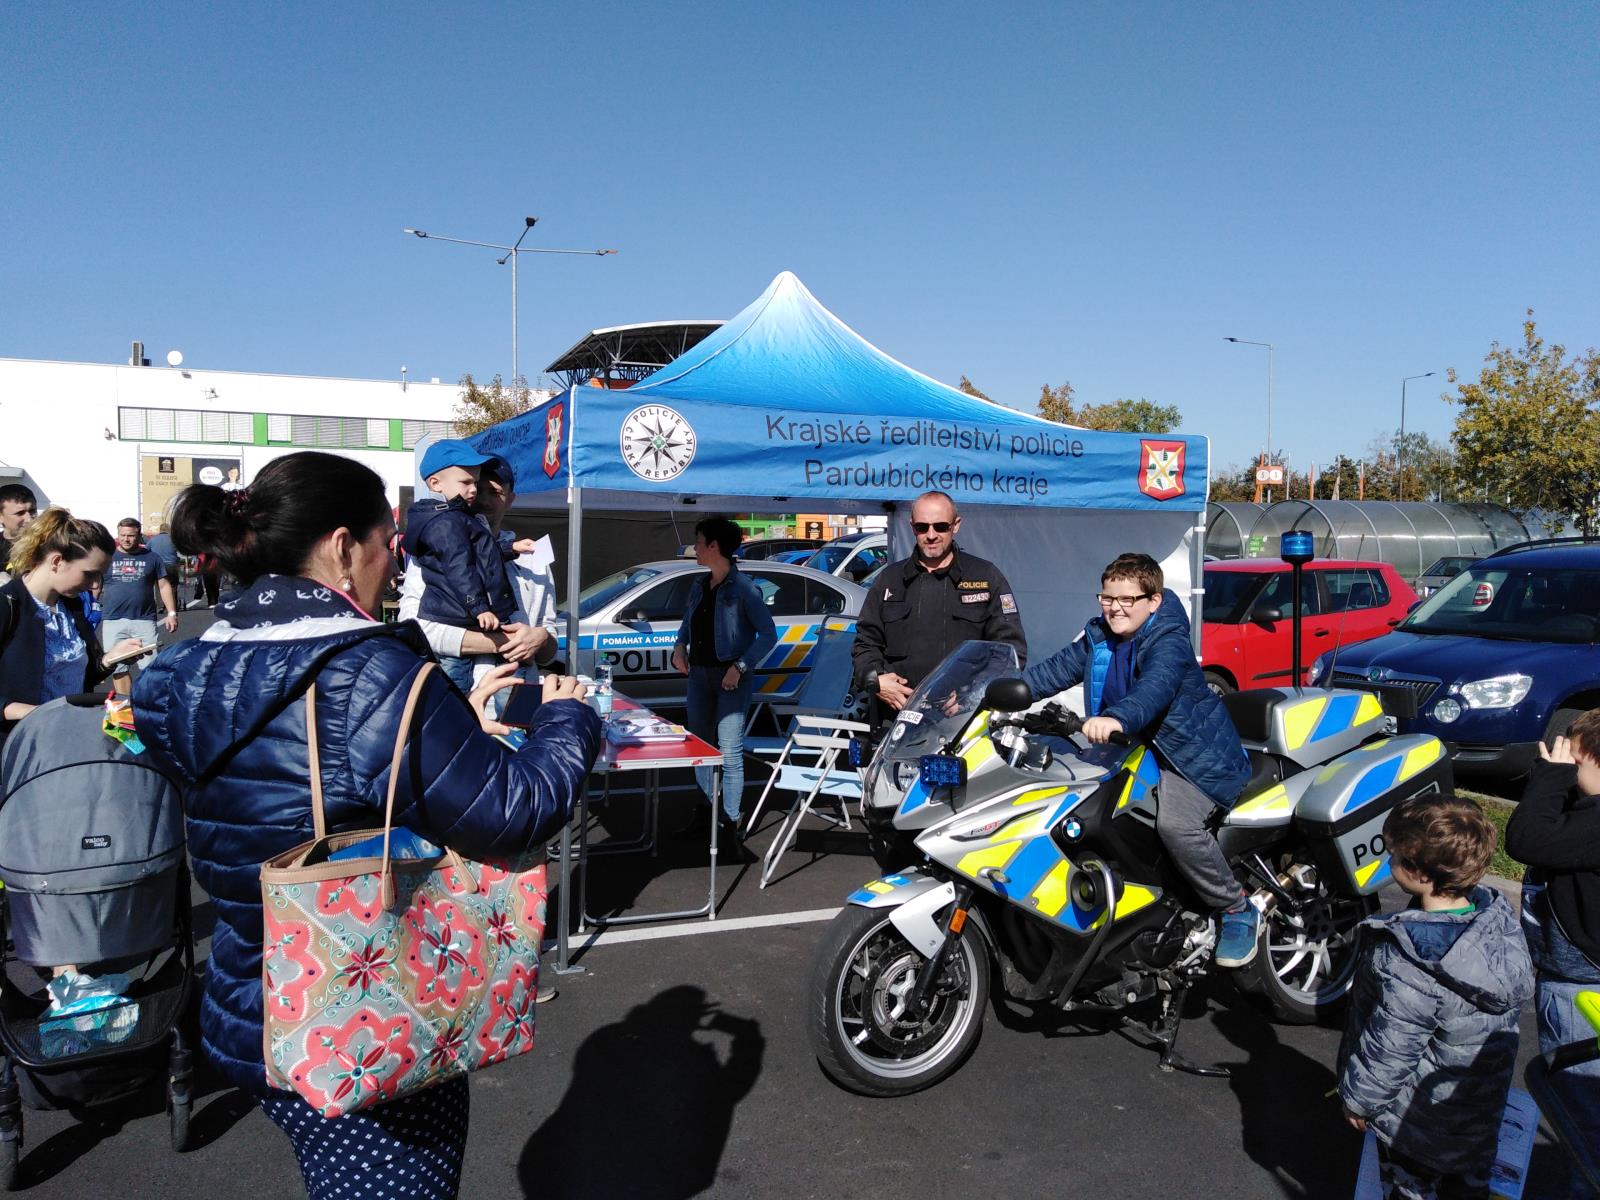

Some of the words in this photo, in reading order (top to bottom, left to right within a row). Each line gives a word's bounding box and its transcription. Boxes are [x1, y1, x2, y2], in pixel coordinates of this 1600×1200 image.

[633, 408, 681, 426] POLICIE
[765, 414, 871, 449] Krajské
[1010, 432, 1085, 459] policie
[644, 430, 693, 478] REPUBLIKY
[804, 459, 984, 491] Pardubického
[993, 468, 1049, 500] kraje
[602, 636, 643, 645] POMÁHAT
